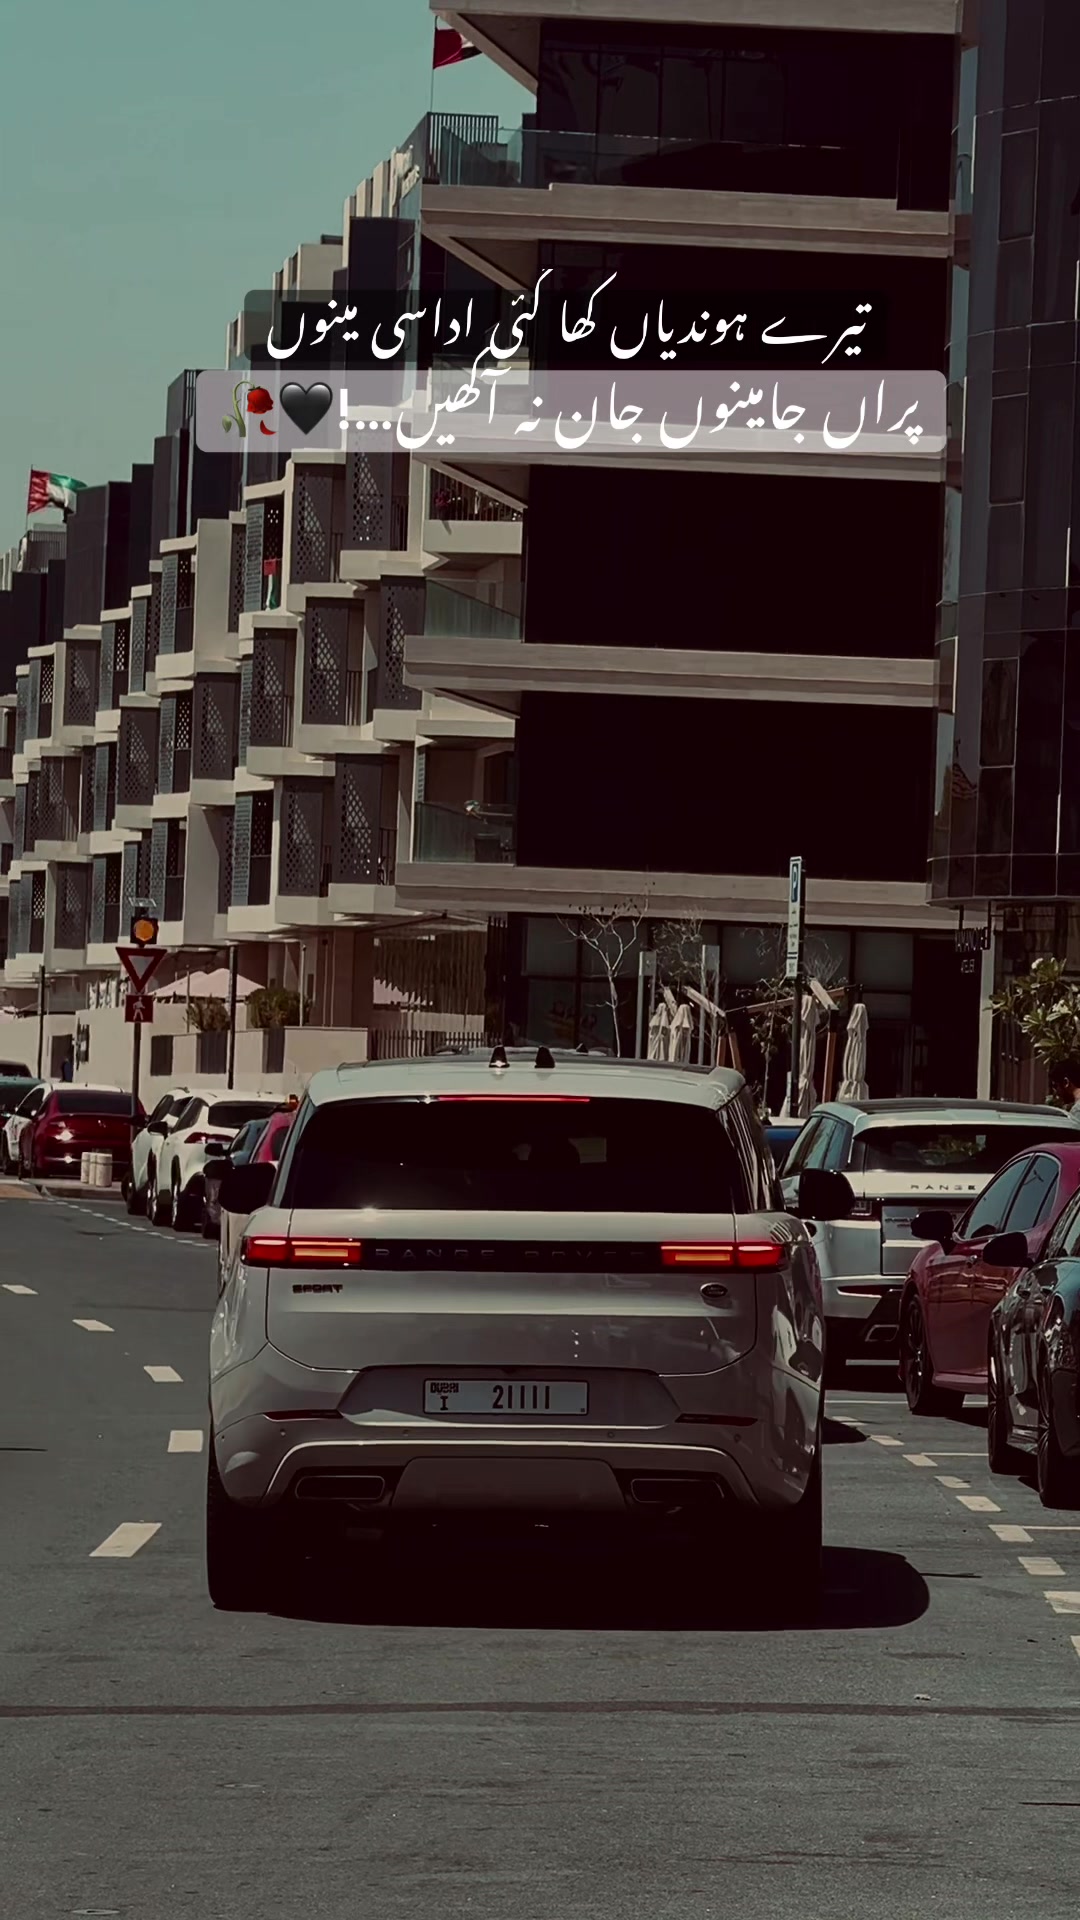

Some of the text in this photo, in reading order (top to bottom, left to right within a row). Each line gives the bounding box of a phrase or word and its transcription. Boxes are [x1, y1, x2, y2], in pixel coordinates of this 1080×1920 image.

[375, 1248, 496, 1258] RANGE
[292, 1284, 343, 1294] SPORT
[492, 1385, 550, 1409] 21111
